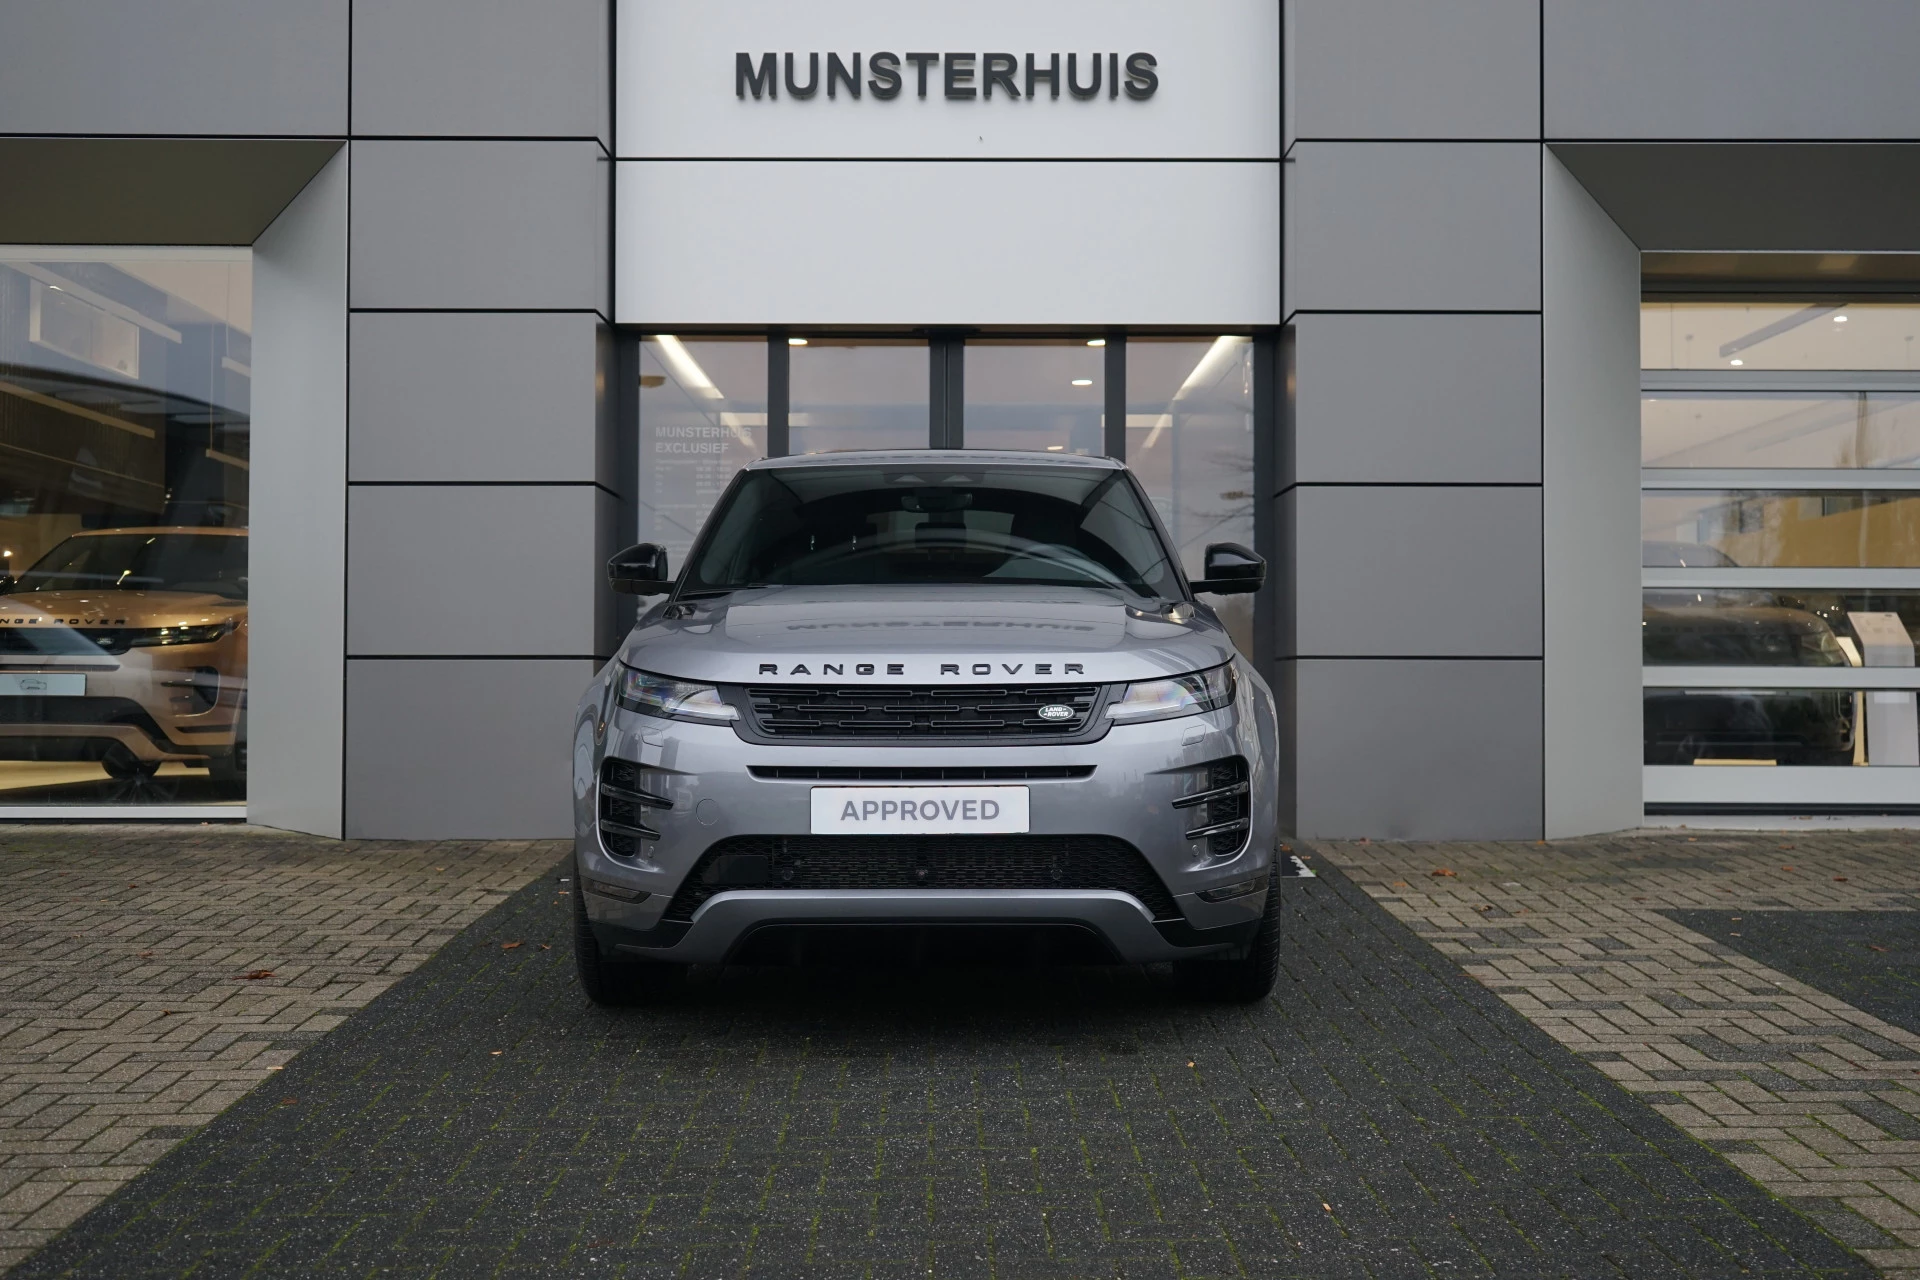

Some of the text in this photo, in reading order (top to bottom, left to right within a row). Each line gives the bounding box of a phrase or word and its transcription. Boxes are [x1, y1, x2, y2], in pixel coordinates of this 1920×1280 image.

[735, 51, 1159, 99] MUNSTERHUIS
[655, 426, 752, 438] MUNSTERHUIS
[655, 442, 729, 453] EXCLUSIEF
[759, 663, 1085, 676] RANGE ROVER
[840, 799, 1000, 821] APPROVED
